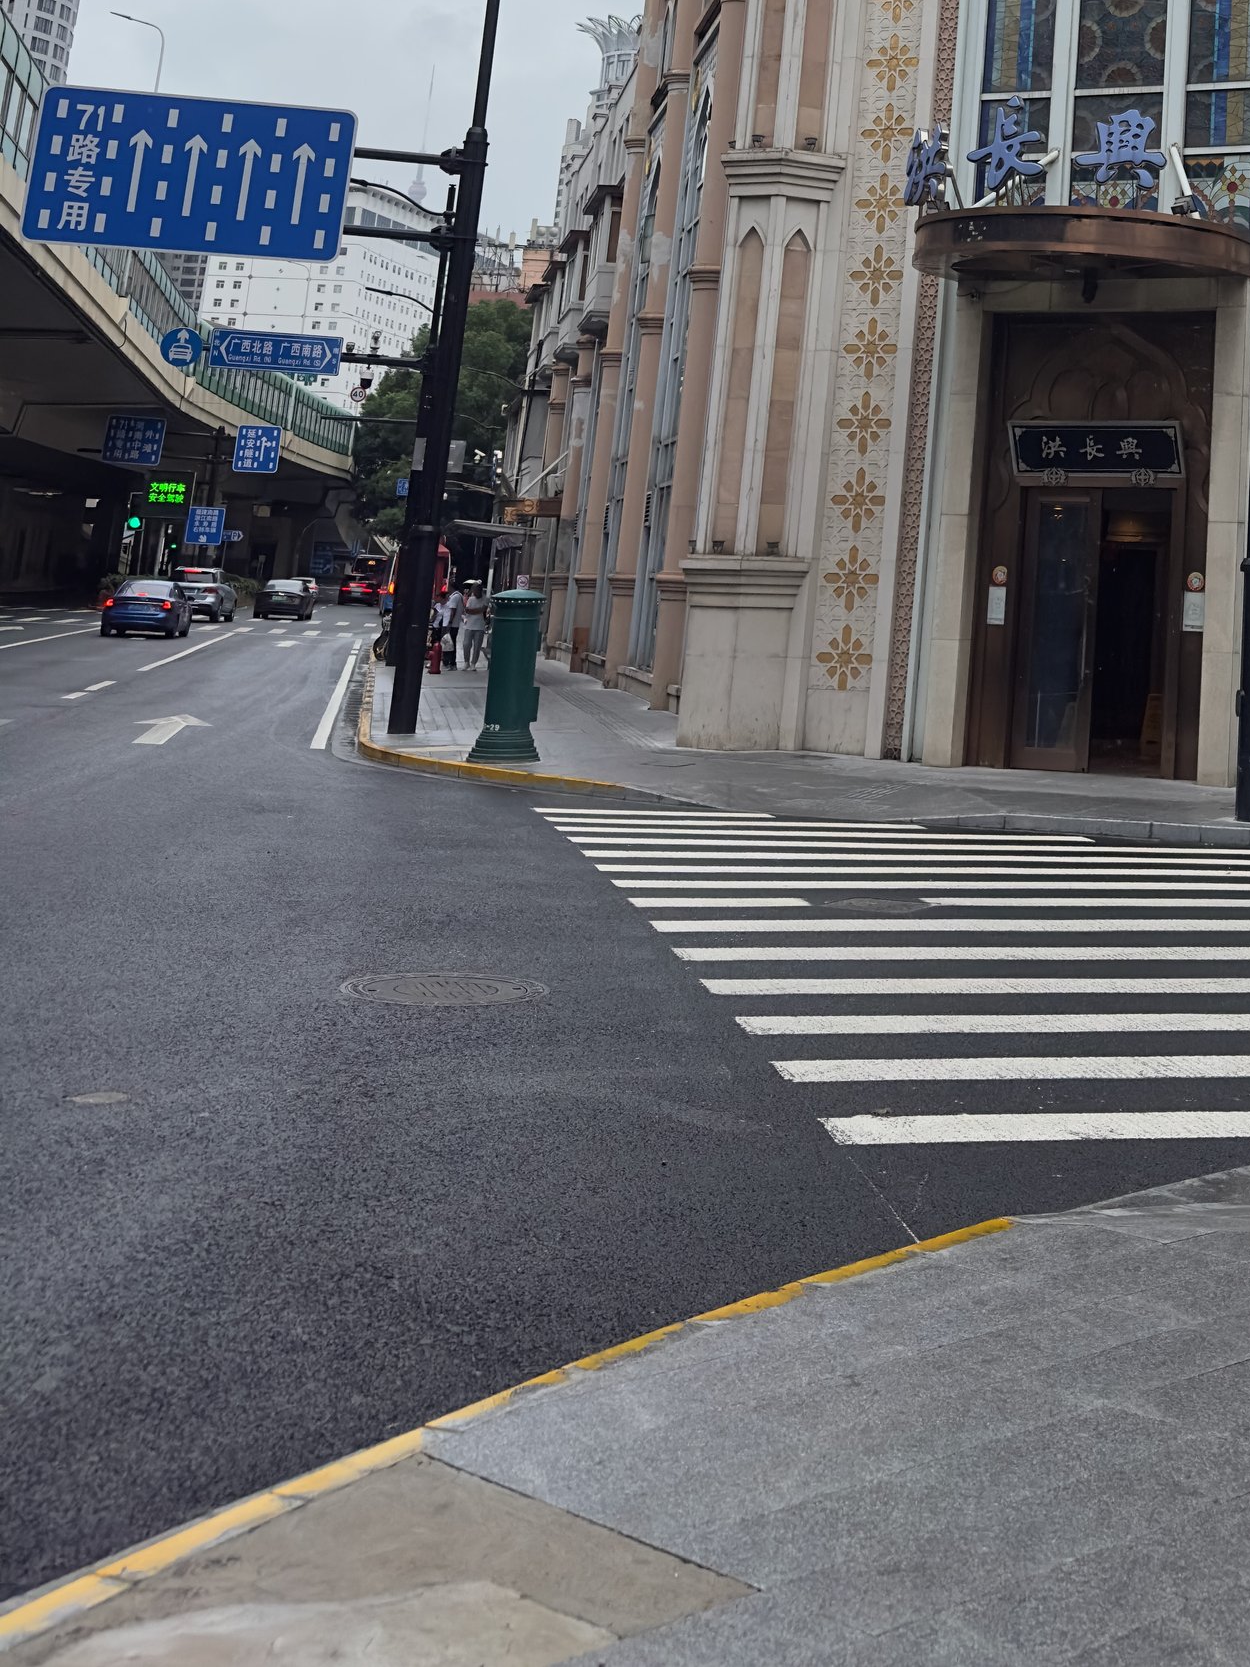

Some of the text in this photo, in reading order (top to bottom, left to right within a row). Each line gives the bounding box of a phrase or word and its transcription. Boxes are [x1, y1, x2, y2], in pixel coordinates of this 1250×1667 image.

[229, 339, 273, 355] 广西北路
[279, 342, 323, 358] 广西南路
[352, 390, 364, 399] 40
[1041, 435, 1143, 461] 洪長興
